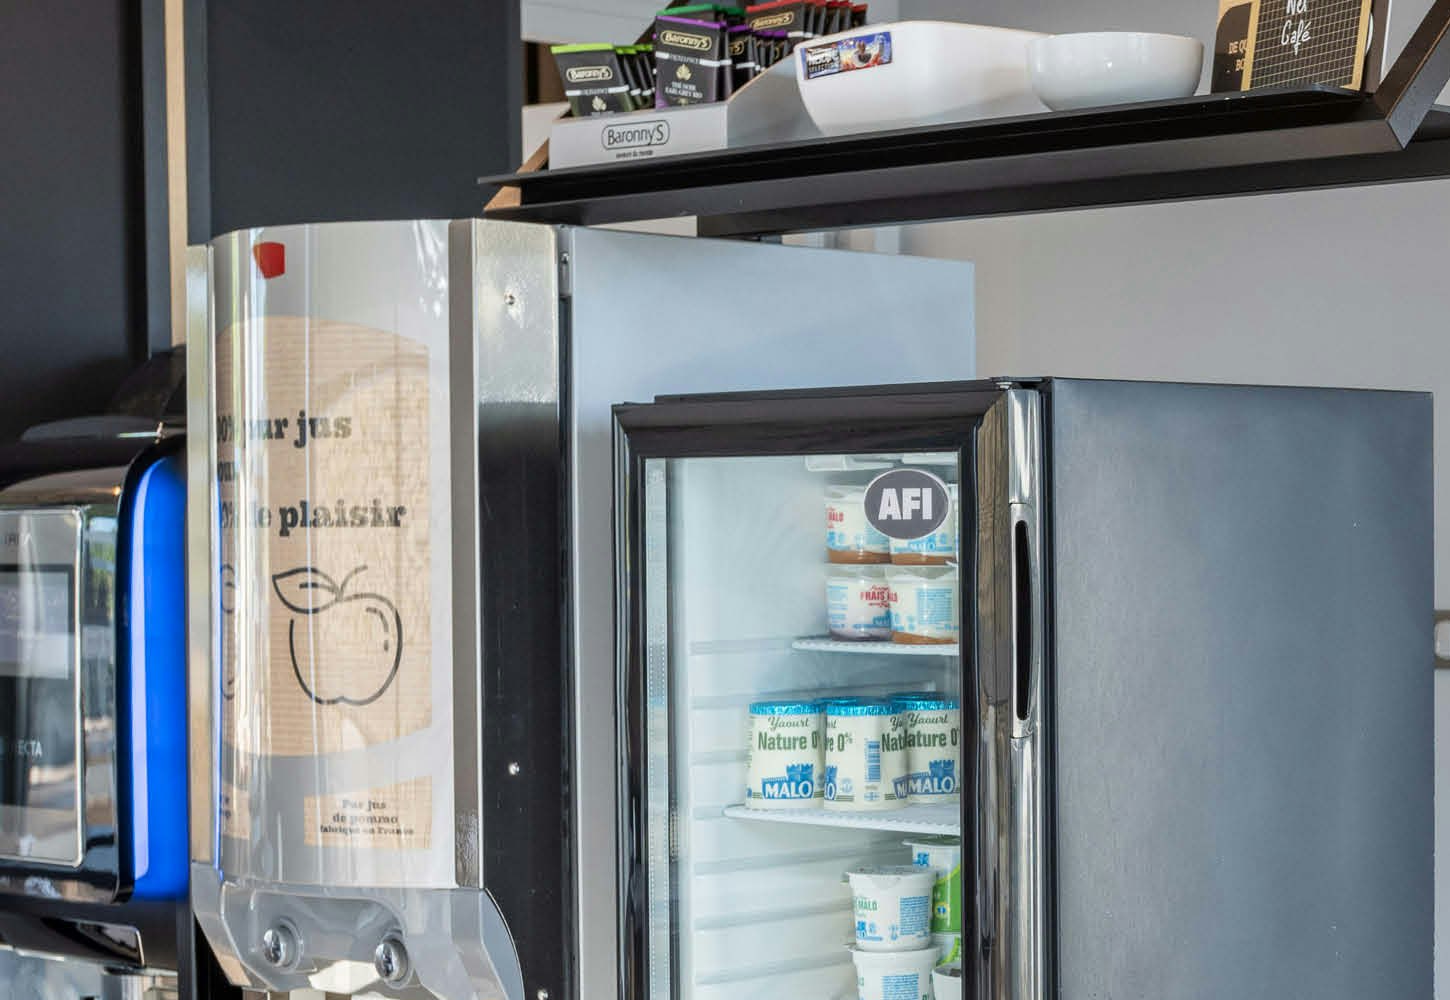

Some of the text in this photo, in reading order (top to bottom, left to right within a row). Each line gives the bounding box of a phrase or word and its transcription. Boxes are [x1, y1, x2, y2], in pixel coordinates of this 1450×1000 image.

[1280, 19, 1312, 55] Café
[293, 410, 353, 448] jus
[278, 498, 408, 537] plaisir
[877, 487, 934, 521] AFI
[757, 731, 808, 751] Nature
[764, 780, 812, 799] MALO
[908, 776, 957, 795] MALO
